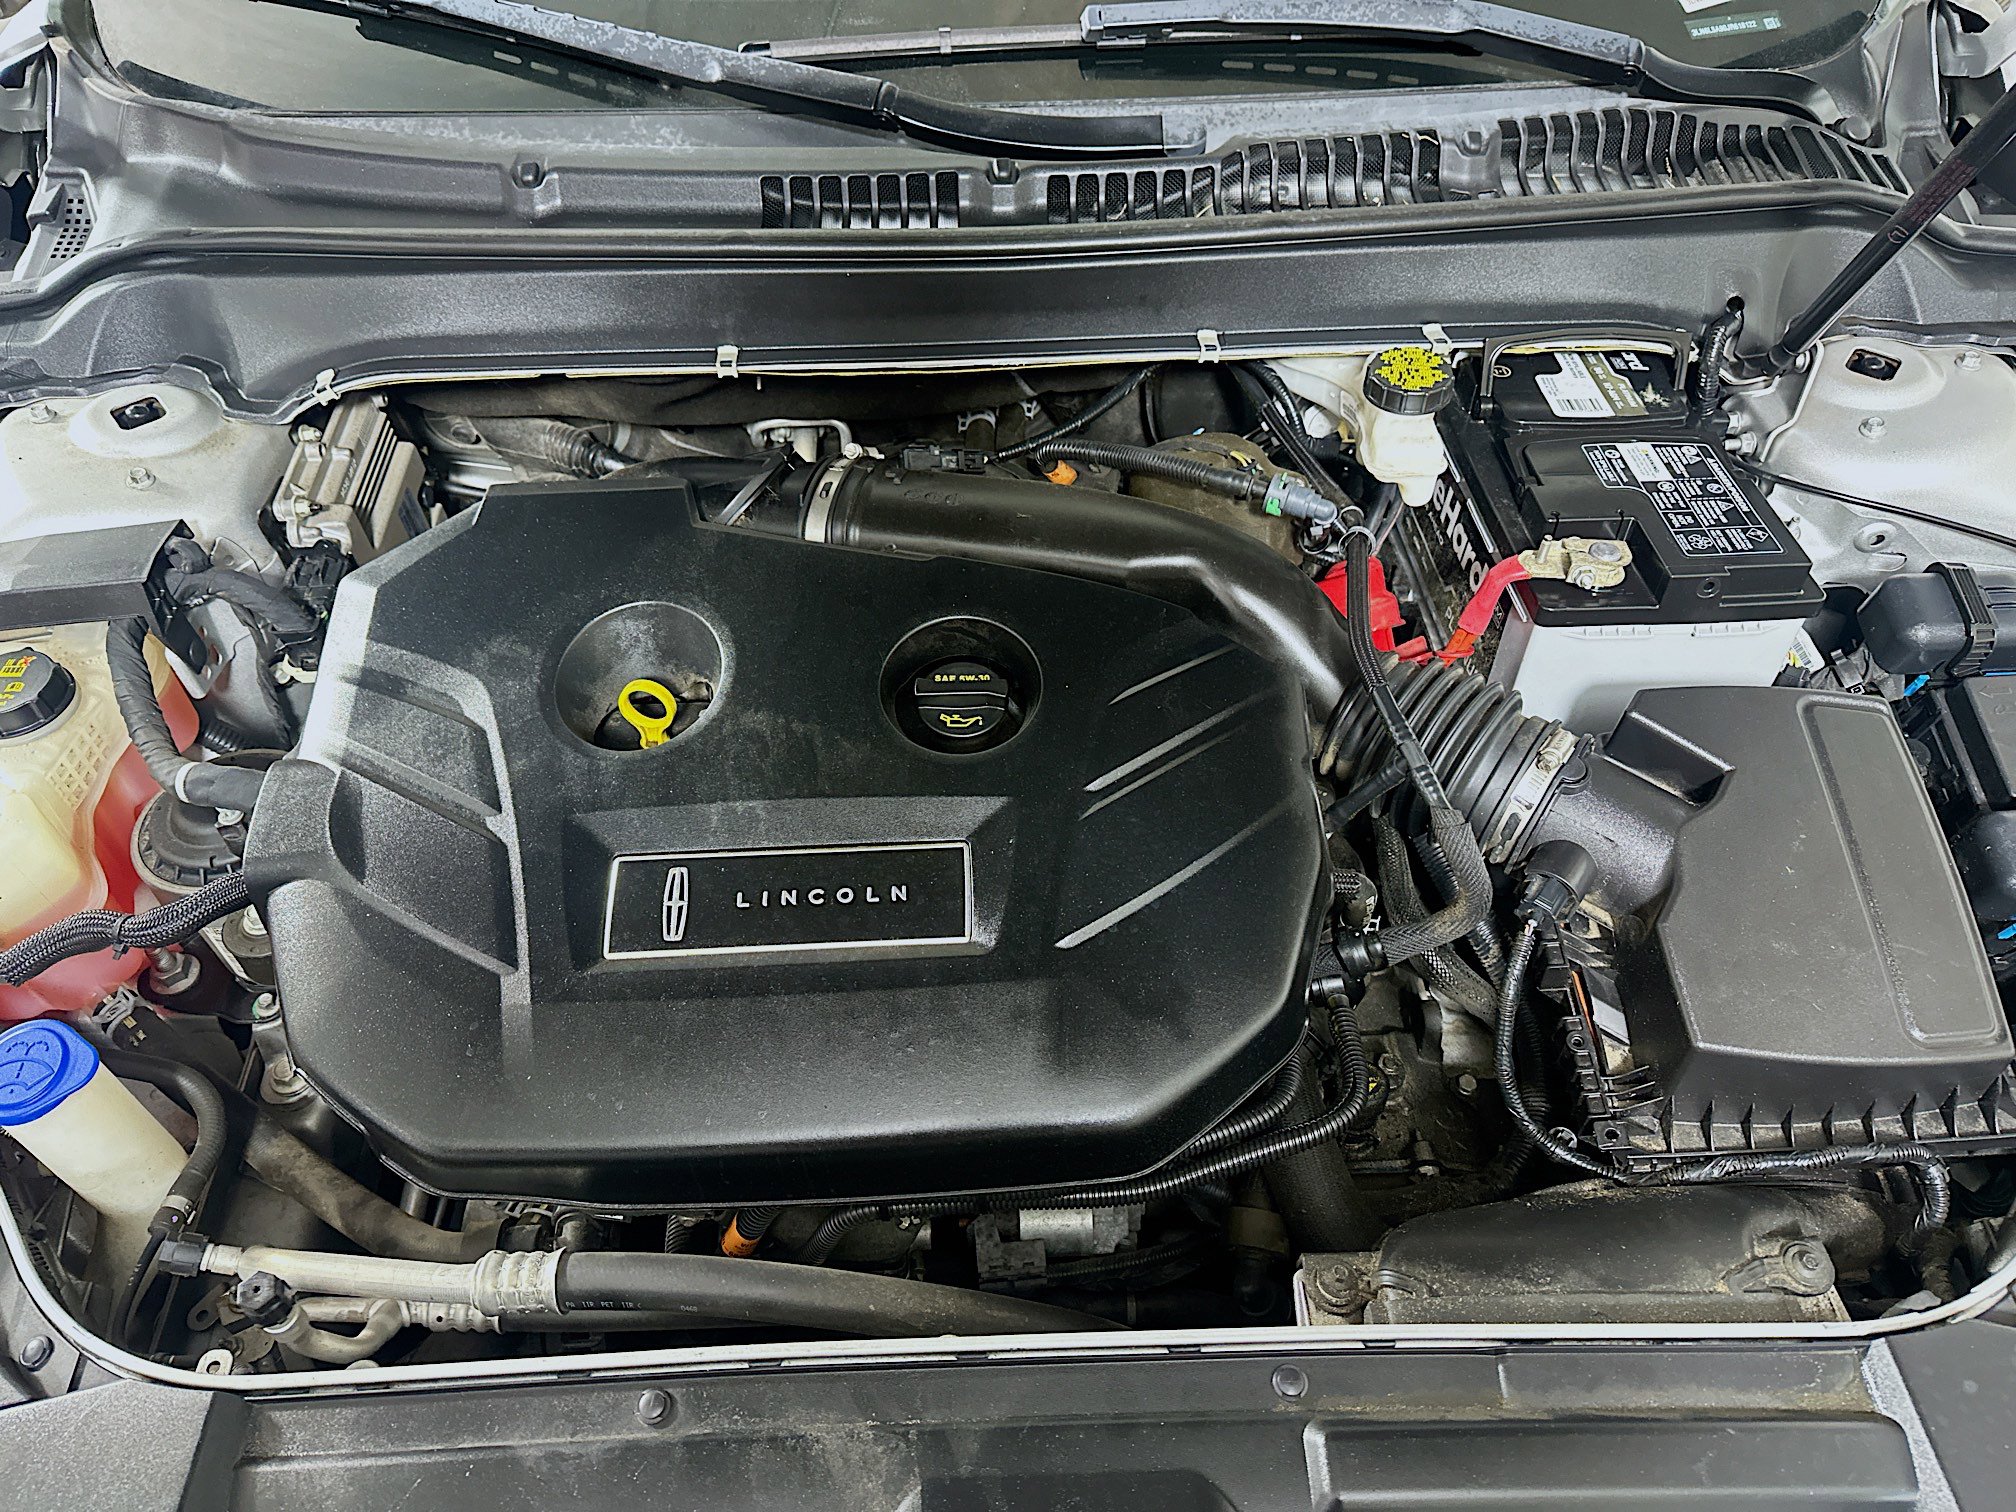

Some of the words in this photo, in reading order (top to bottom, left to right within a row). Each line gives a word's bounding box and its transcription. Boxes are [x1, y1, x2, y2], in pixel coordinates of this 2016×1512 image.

[1433, 478, 1490, 595] eHard
[934, 674, 956, 682] SAE
[736, 885, 908, 908] LINCOLN
[600, 1301, 614, 1309] PET
